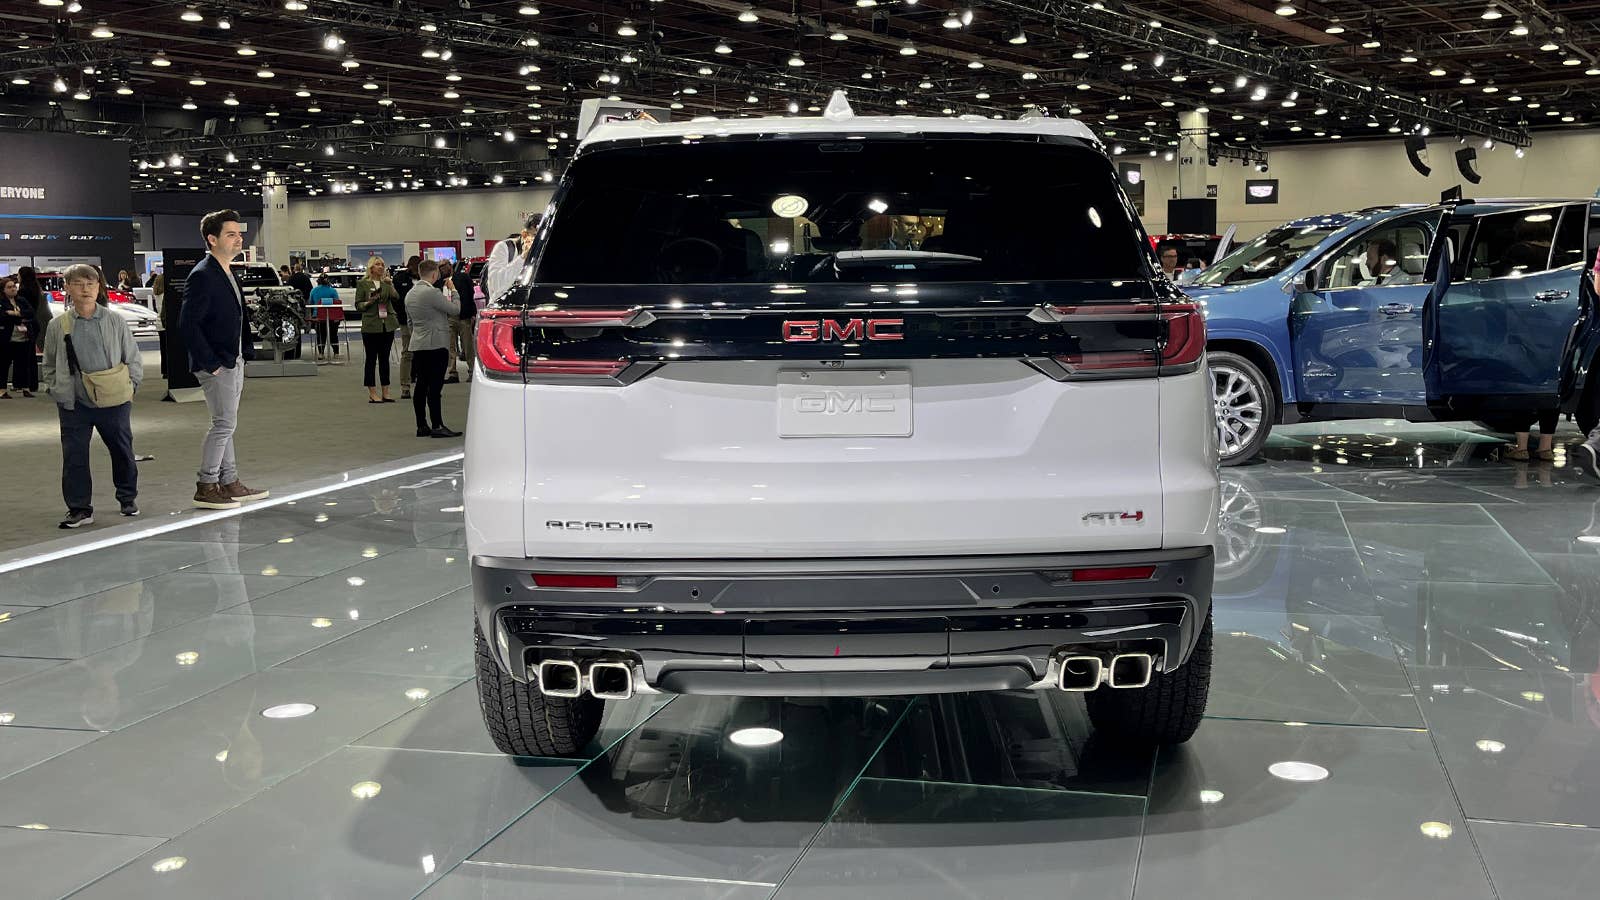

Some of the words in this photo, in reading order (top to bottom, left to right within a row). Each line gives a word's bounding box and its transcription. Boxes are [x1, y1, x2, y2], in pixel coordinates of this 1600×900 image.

[0, 186, 45, 199] ERYONE
[782, 318, 904, 342] GMC
[795, 391, 896, 413] GMC
[545, 520, 653, 531] ACADIA
[1081, 510, 1144, 526] AT4
